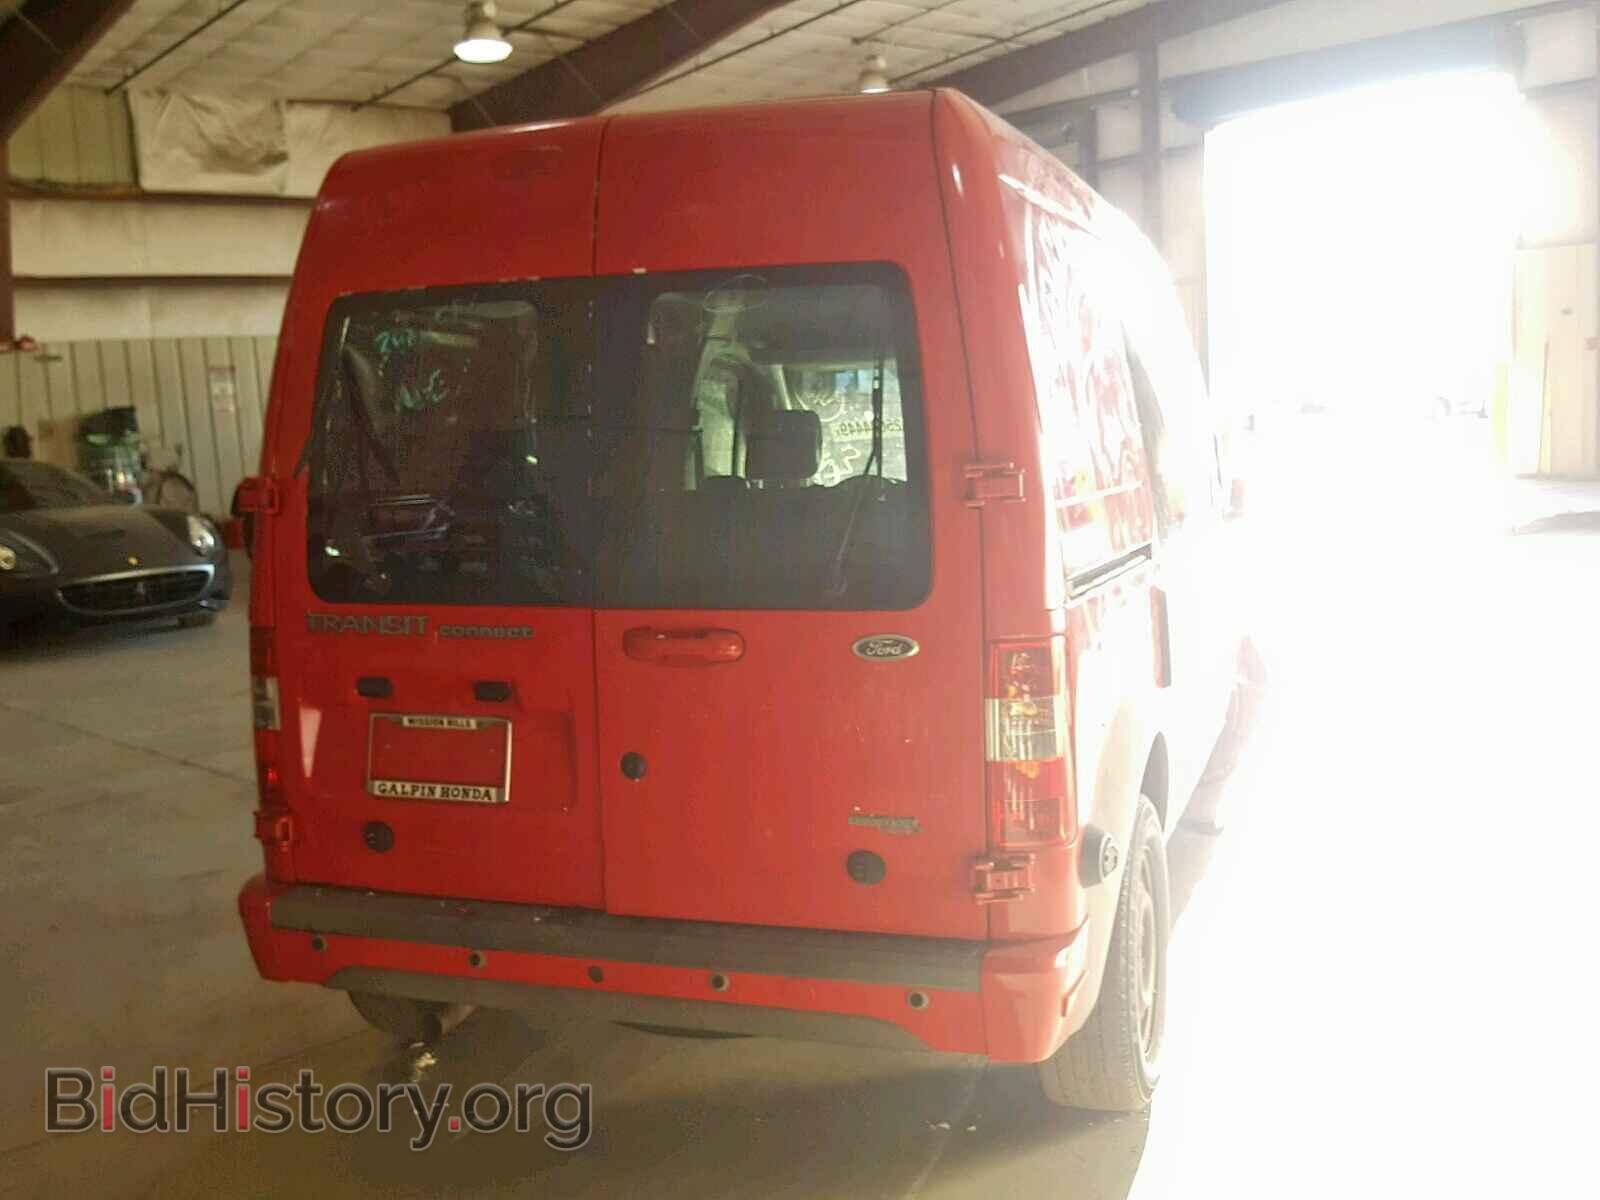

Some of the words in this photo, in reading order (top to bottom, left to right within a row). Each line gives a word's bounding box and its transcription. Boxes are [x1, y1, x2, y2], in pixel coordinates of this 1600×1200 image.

[305, 611, 428, 635] TRANSIT
[377, 783, 437, 798] GALPIN
[441, 786, 493, 801] HONDA
